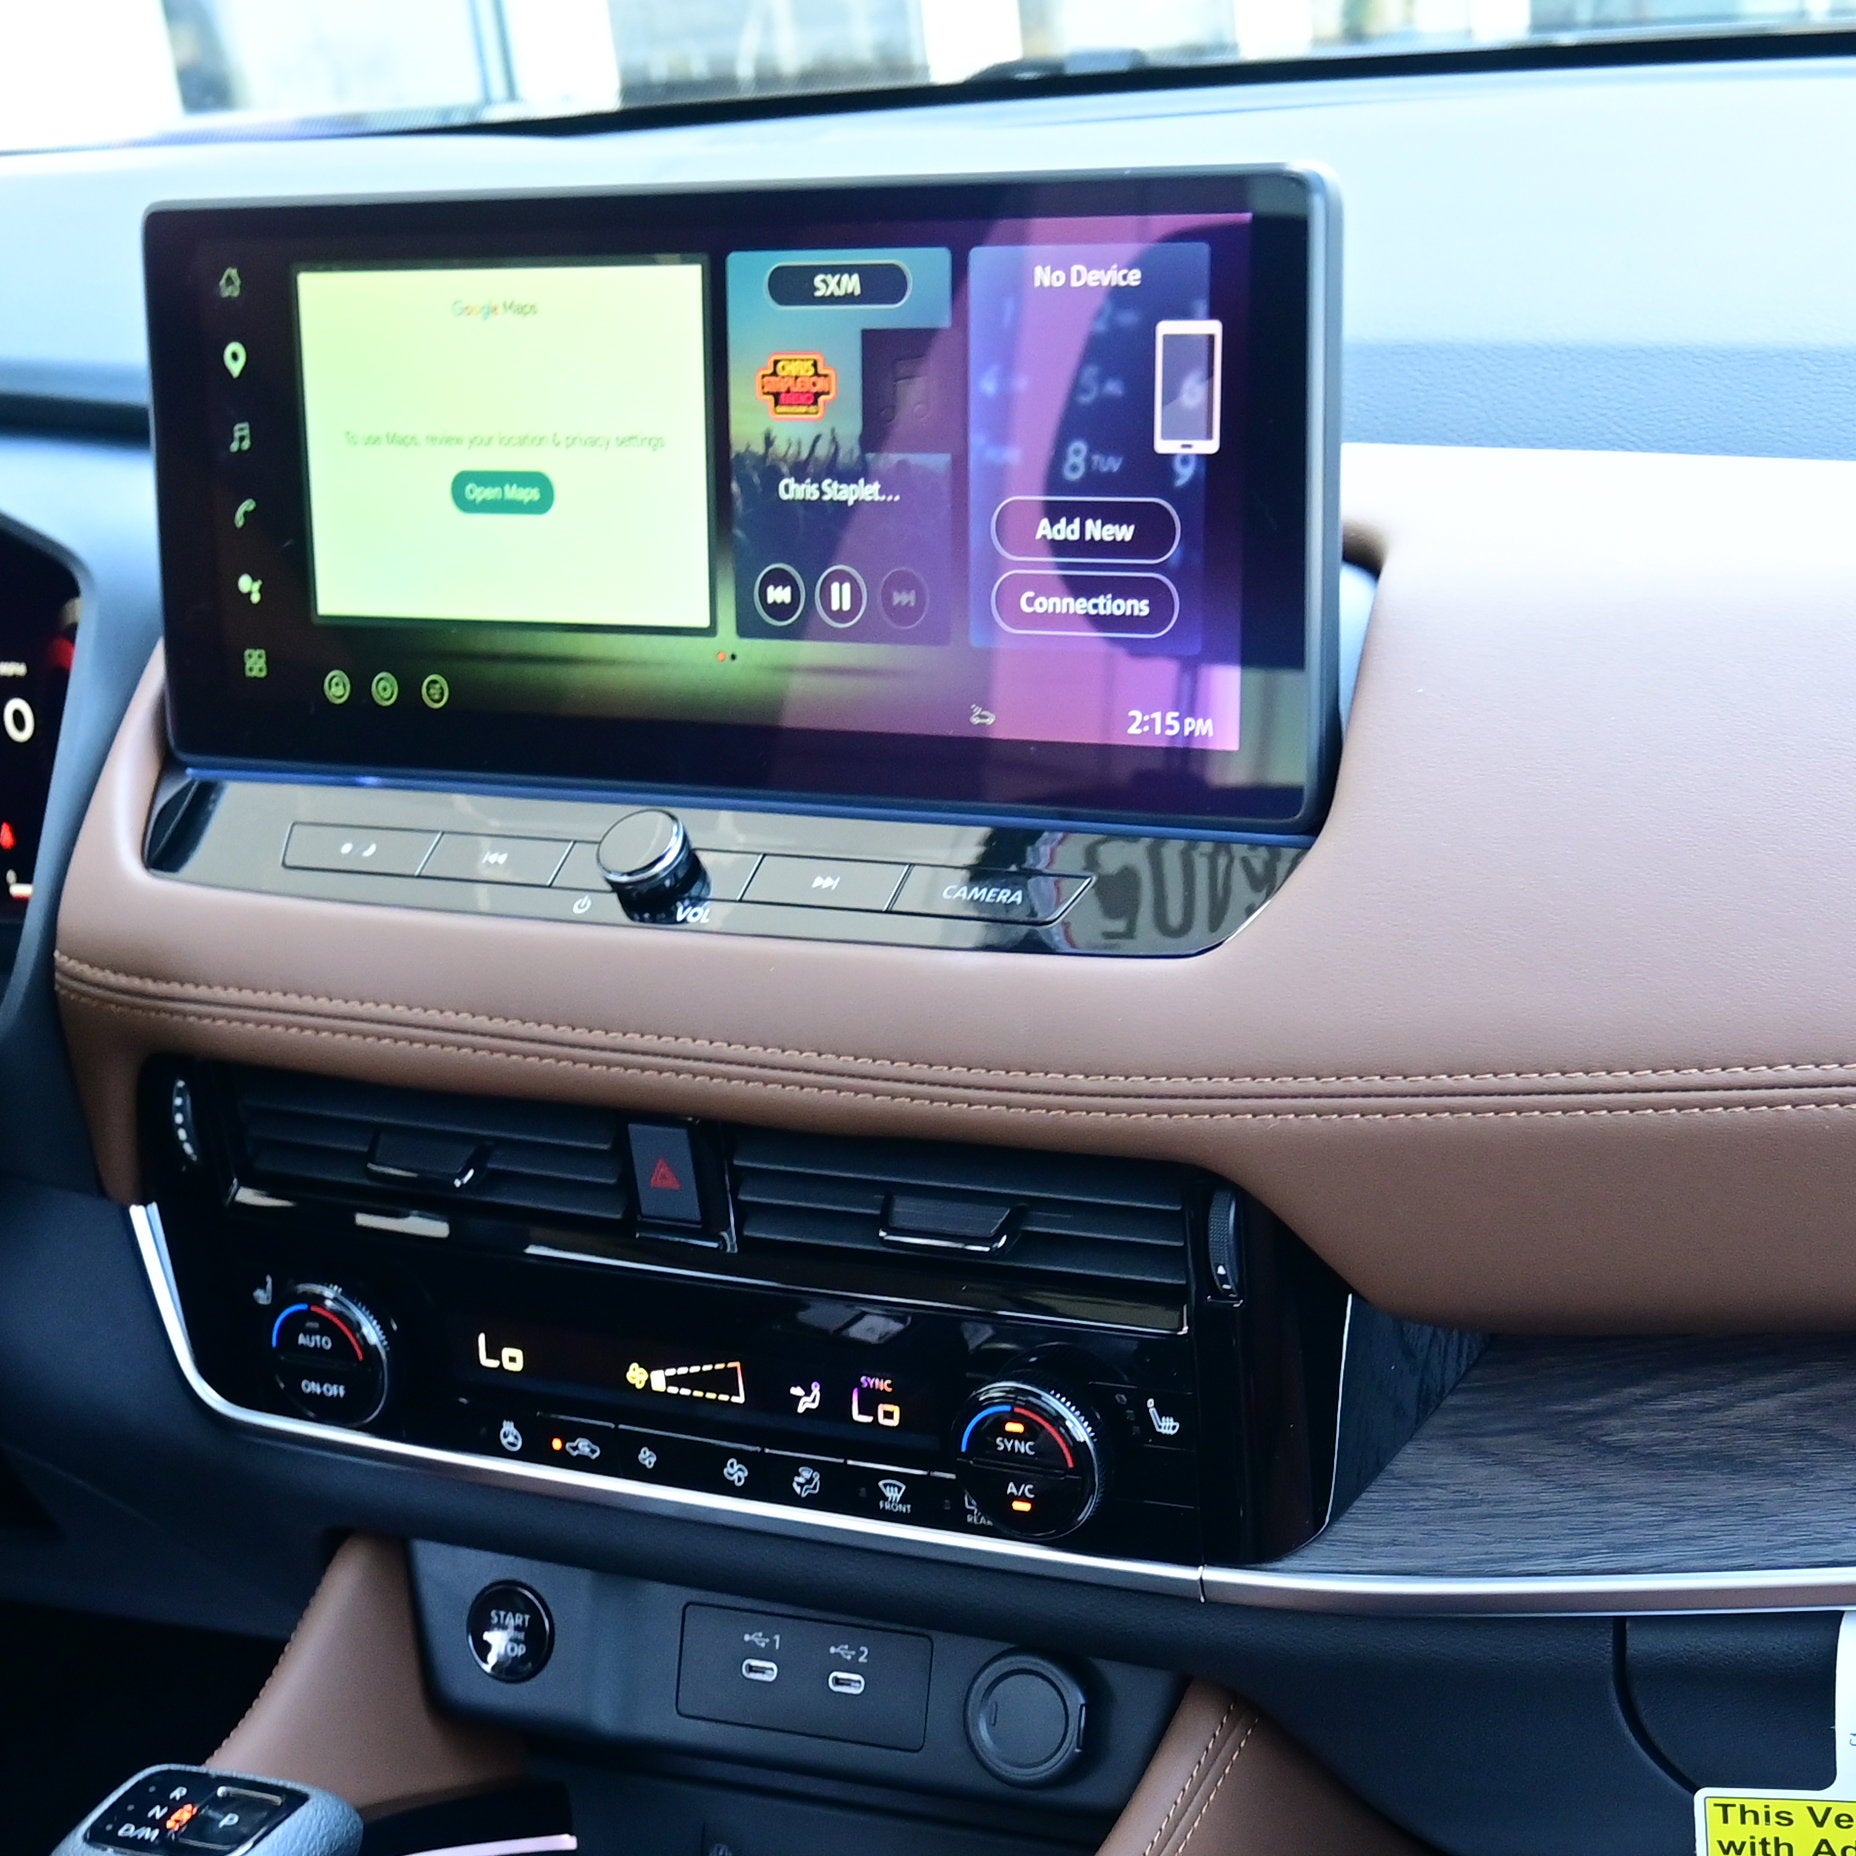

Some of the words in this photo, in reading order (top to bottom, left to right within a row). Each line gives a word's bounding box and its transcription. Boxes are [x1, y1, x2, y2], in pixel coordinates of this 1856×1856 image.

[813, 273, 861, 297] SXM
[1034, 265, 1066, 288] No
[1070, 264, 1142, 288] Device
[451, 300, 500, 319] Google
[503, 301, 538, 318] Maps
[464, 483, 502, 504] Open
[504, 483, 541, 504] Maps
[778, 477, 820, 501] Chris
[1035, 517, 1081, 541] Add
[1084, 518, 1135, 542] New
[1019, 591, 1150, 616] Connections
[3, 697, 35, 744] 0
[1127, 710, 1181, 737] 2:15
[1184, 716, 1214, 738] PM
[942, 884, 1023, 905] CAMERA
[675, 905, 711, 923] VOL
[297, 1332, 333, 1351] AUTO
[860, 1375, 893, 1392] SYNC
[996, 1436, 1036, 1456] SYNC
[1007, 1481, 1035, 1500] A/C
[879, 1500, 912, 1514] FRONT
[490, 1609, 532, 1628] START
[858, 1646, 868, 1662] 2
[170, 1786, 188, 1800] R
[147, 1805, 168, 1820] N
[218, 1813, 239, 1828] P
[1715, 1802, 1794, 1827] This
[117, 1823, 160, 1842] D/M
